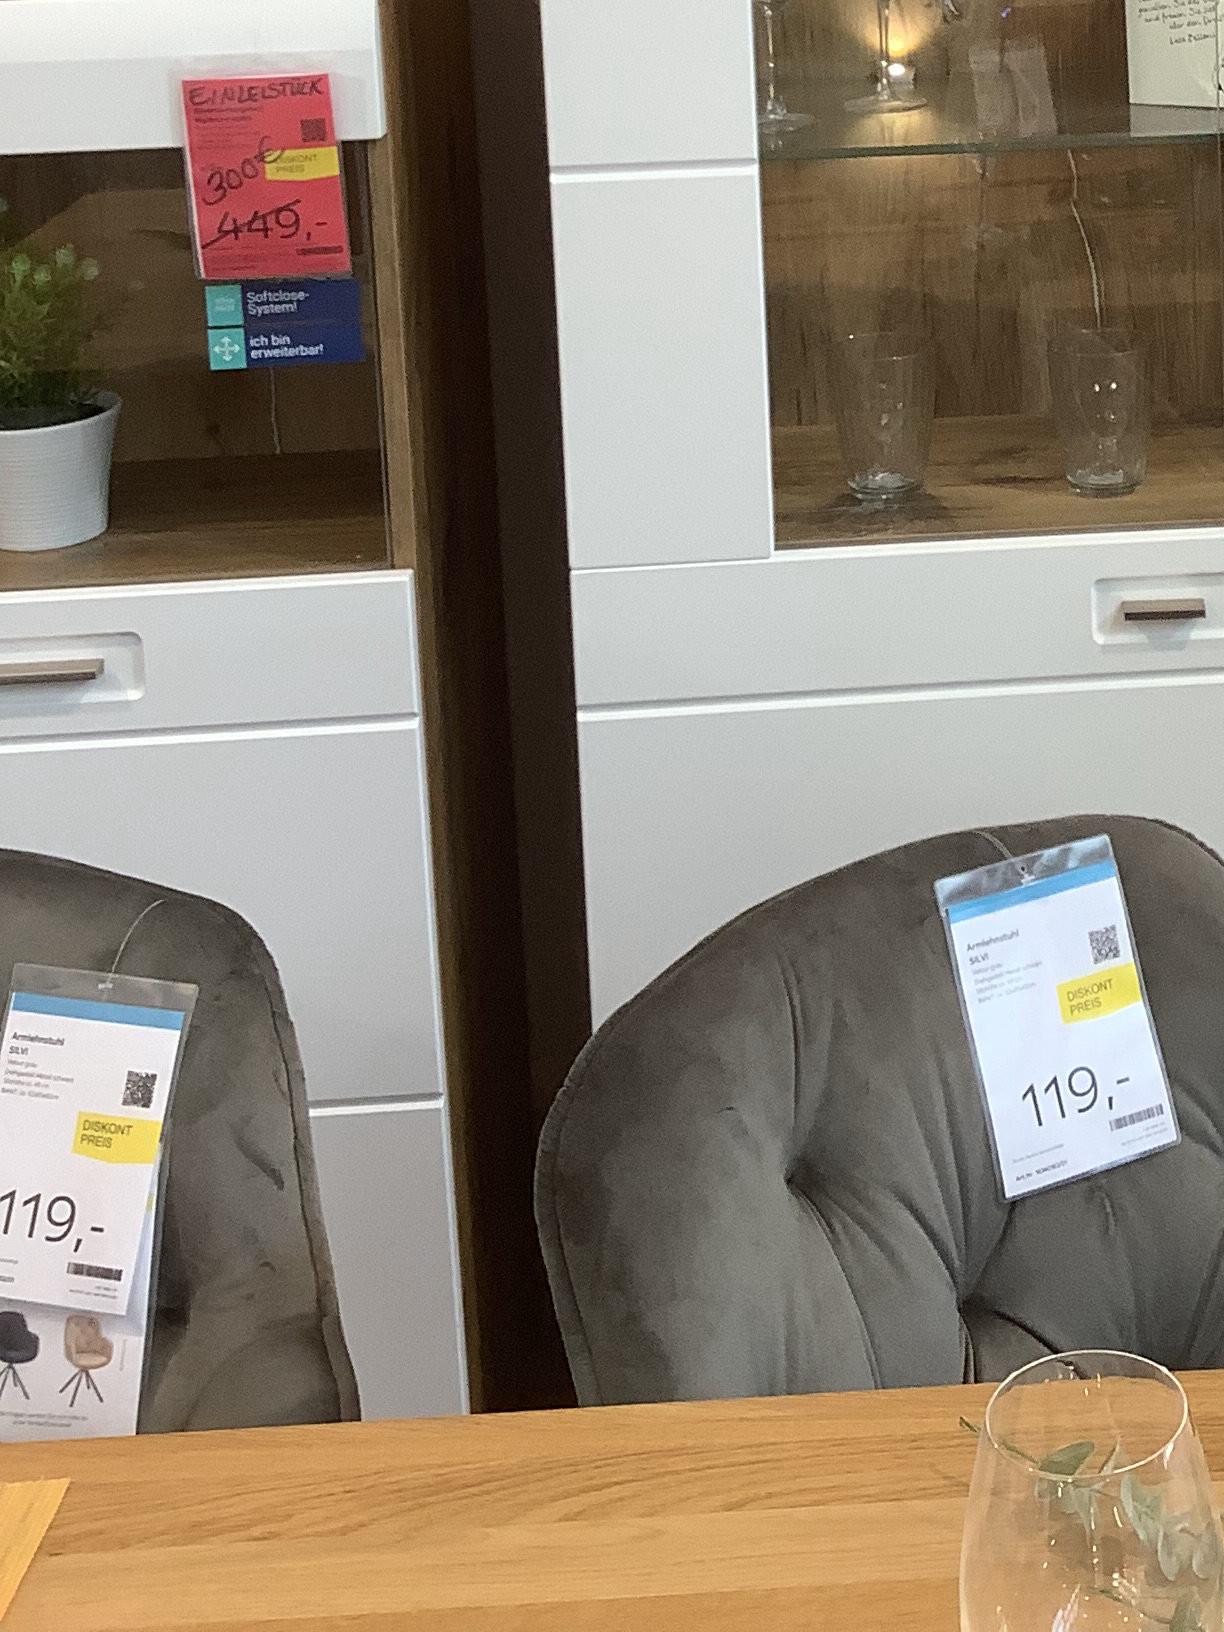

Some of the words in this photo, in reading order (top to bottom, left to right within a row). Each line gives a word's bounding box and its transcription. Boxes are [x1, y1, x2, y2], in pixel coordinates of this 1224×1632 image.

[202, 136, 286, 206] 300€
[214, 206, 328, 242] 449,-
[247, 290, 310, 303] Softclose-
[248, 302, 297, 317] System!
[271, 335, 290, 345] bin
[250, 344, 324, 360] erweiterbar!
[1067, 978, 1113, 1002] DISKONT
[1069, 997, 1102, 1016] PREIS
[1022, 1066, 1130, 1127] 119,-
[82, 1119, 133, 1136] DISKONT
[80, 1134, 113, 1149] PREIS
[0, 1189, 104, 1253] 119,-
